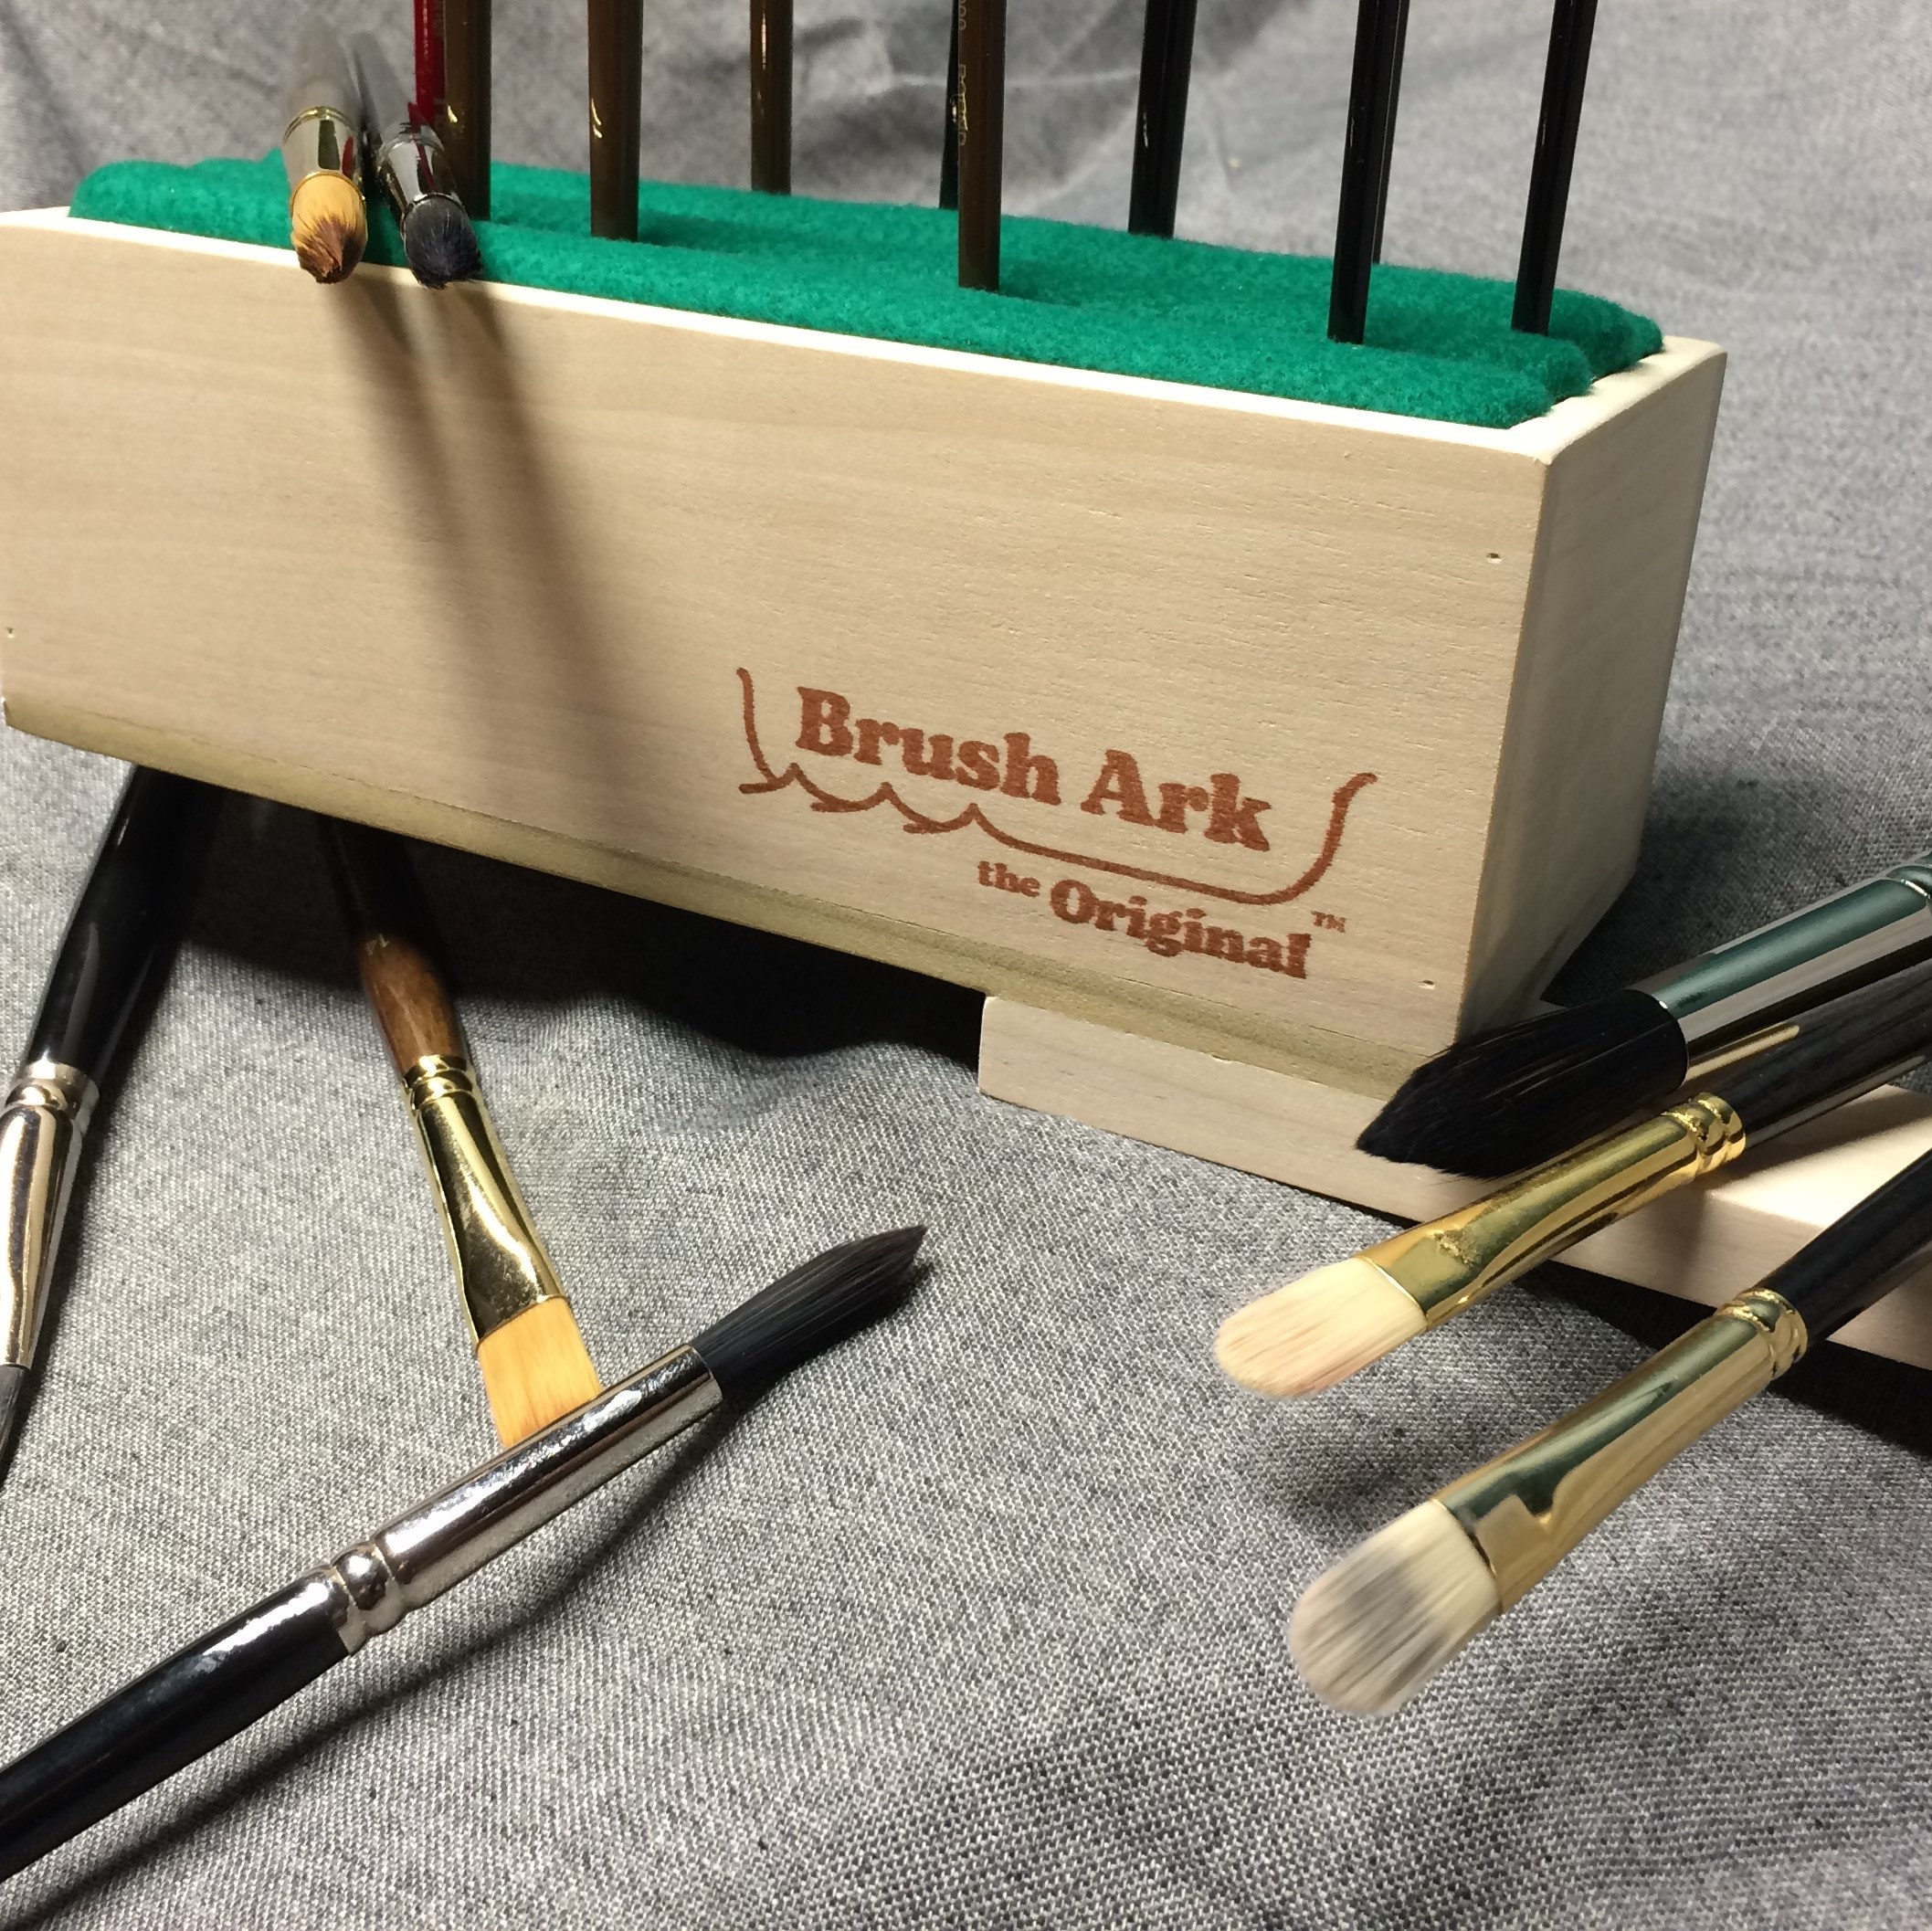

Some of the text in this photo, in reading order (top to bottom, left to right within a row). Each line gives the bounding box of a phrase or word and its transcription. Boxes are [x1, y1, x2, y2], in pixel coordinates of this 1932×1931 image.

[797, 687, 1271, 851] Brush Ark
[977, 861, 1040, 898] the
[1050, 880, 1312, 978] Original
